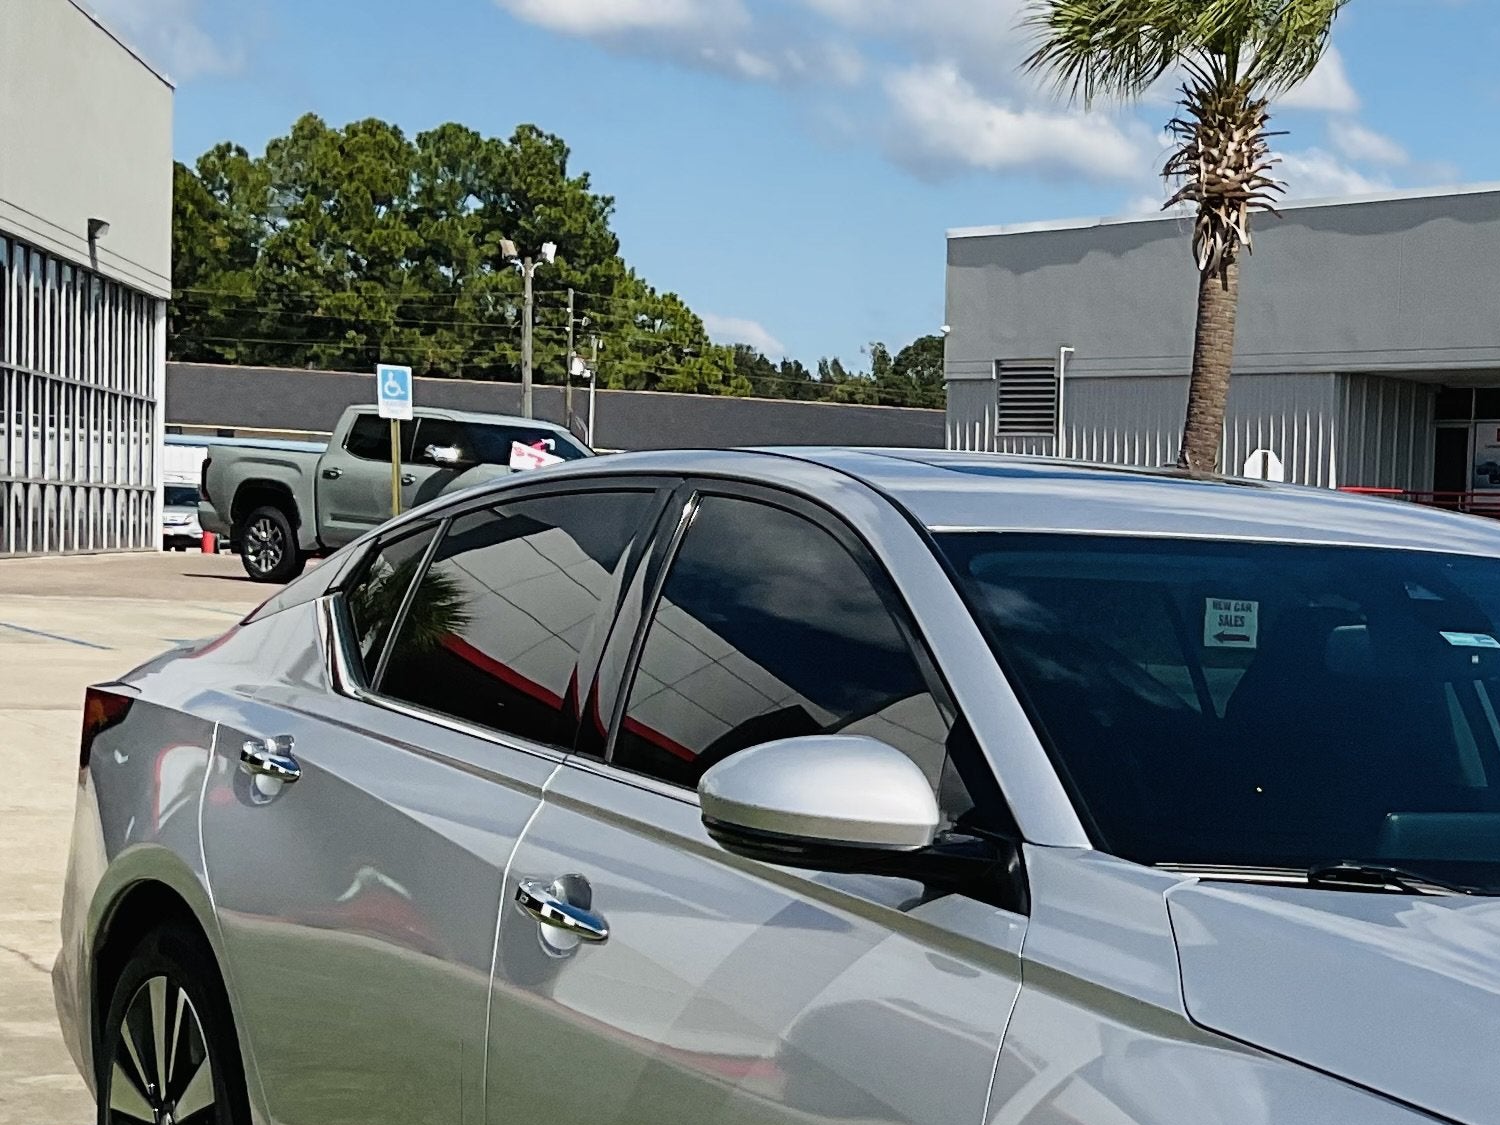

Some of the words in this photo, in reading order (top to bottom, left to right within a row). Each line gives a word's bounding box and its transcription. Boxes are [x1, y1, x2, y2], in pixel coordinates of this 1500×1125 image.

[1213, 600, 1231, 611] NEW
[1234, 602, 1252, 612] CAR
[1218, 614, 1245, 627] SALES
